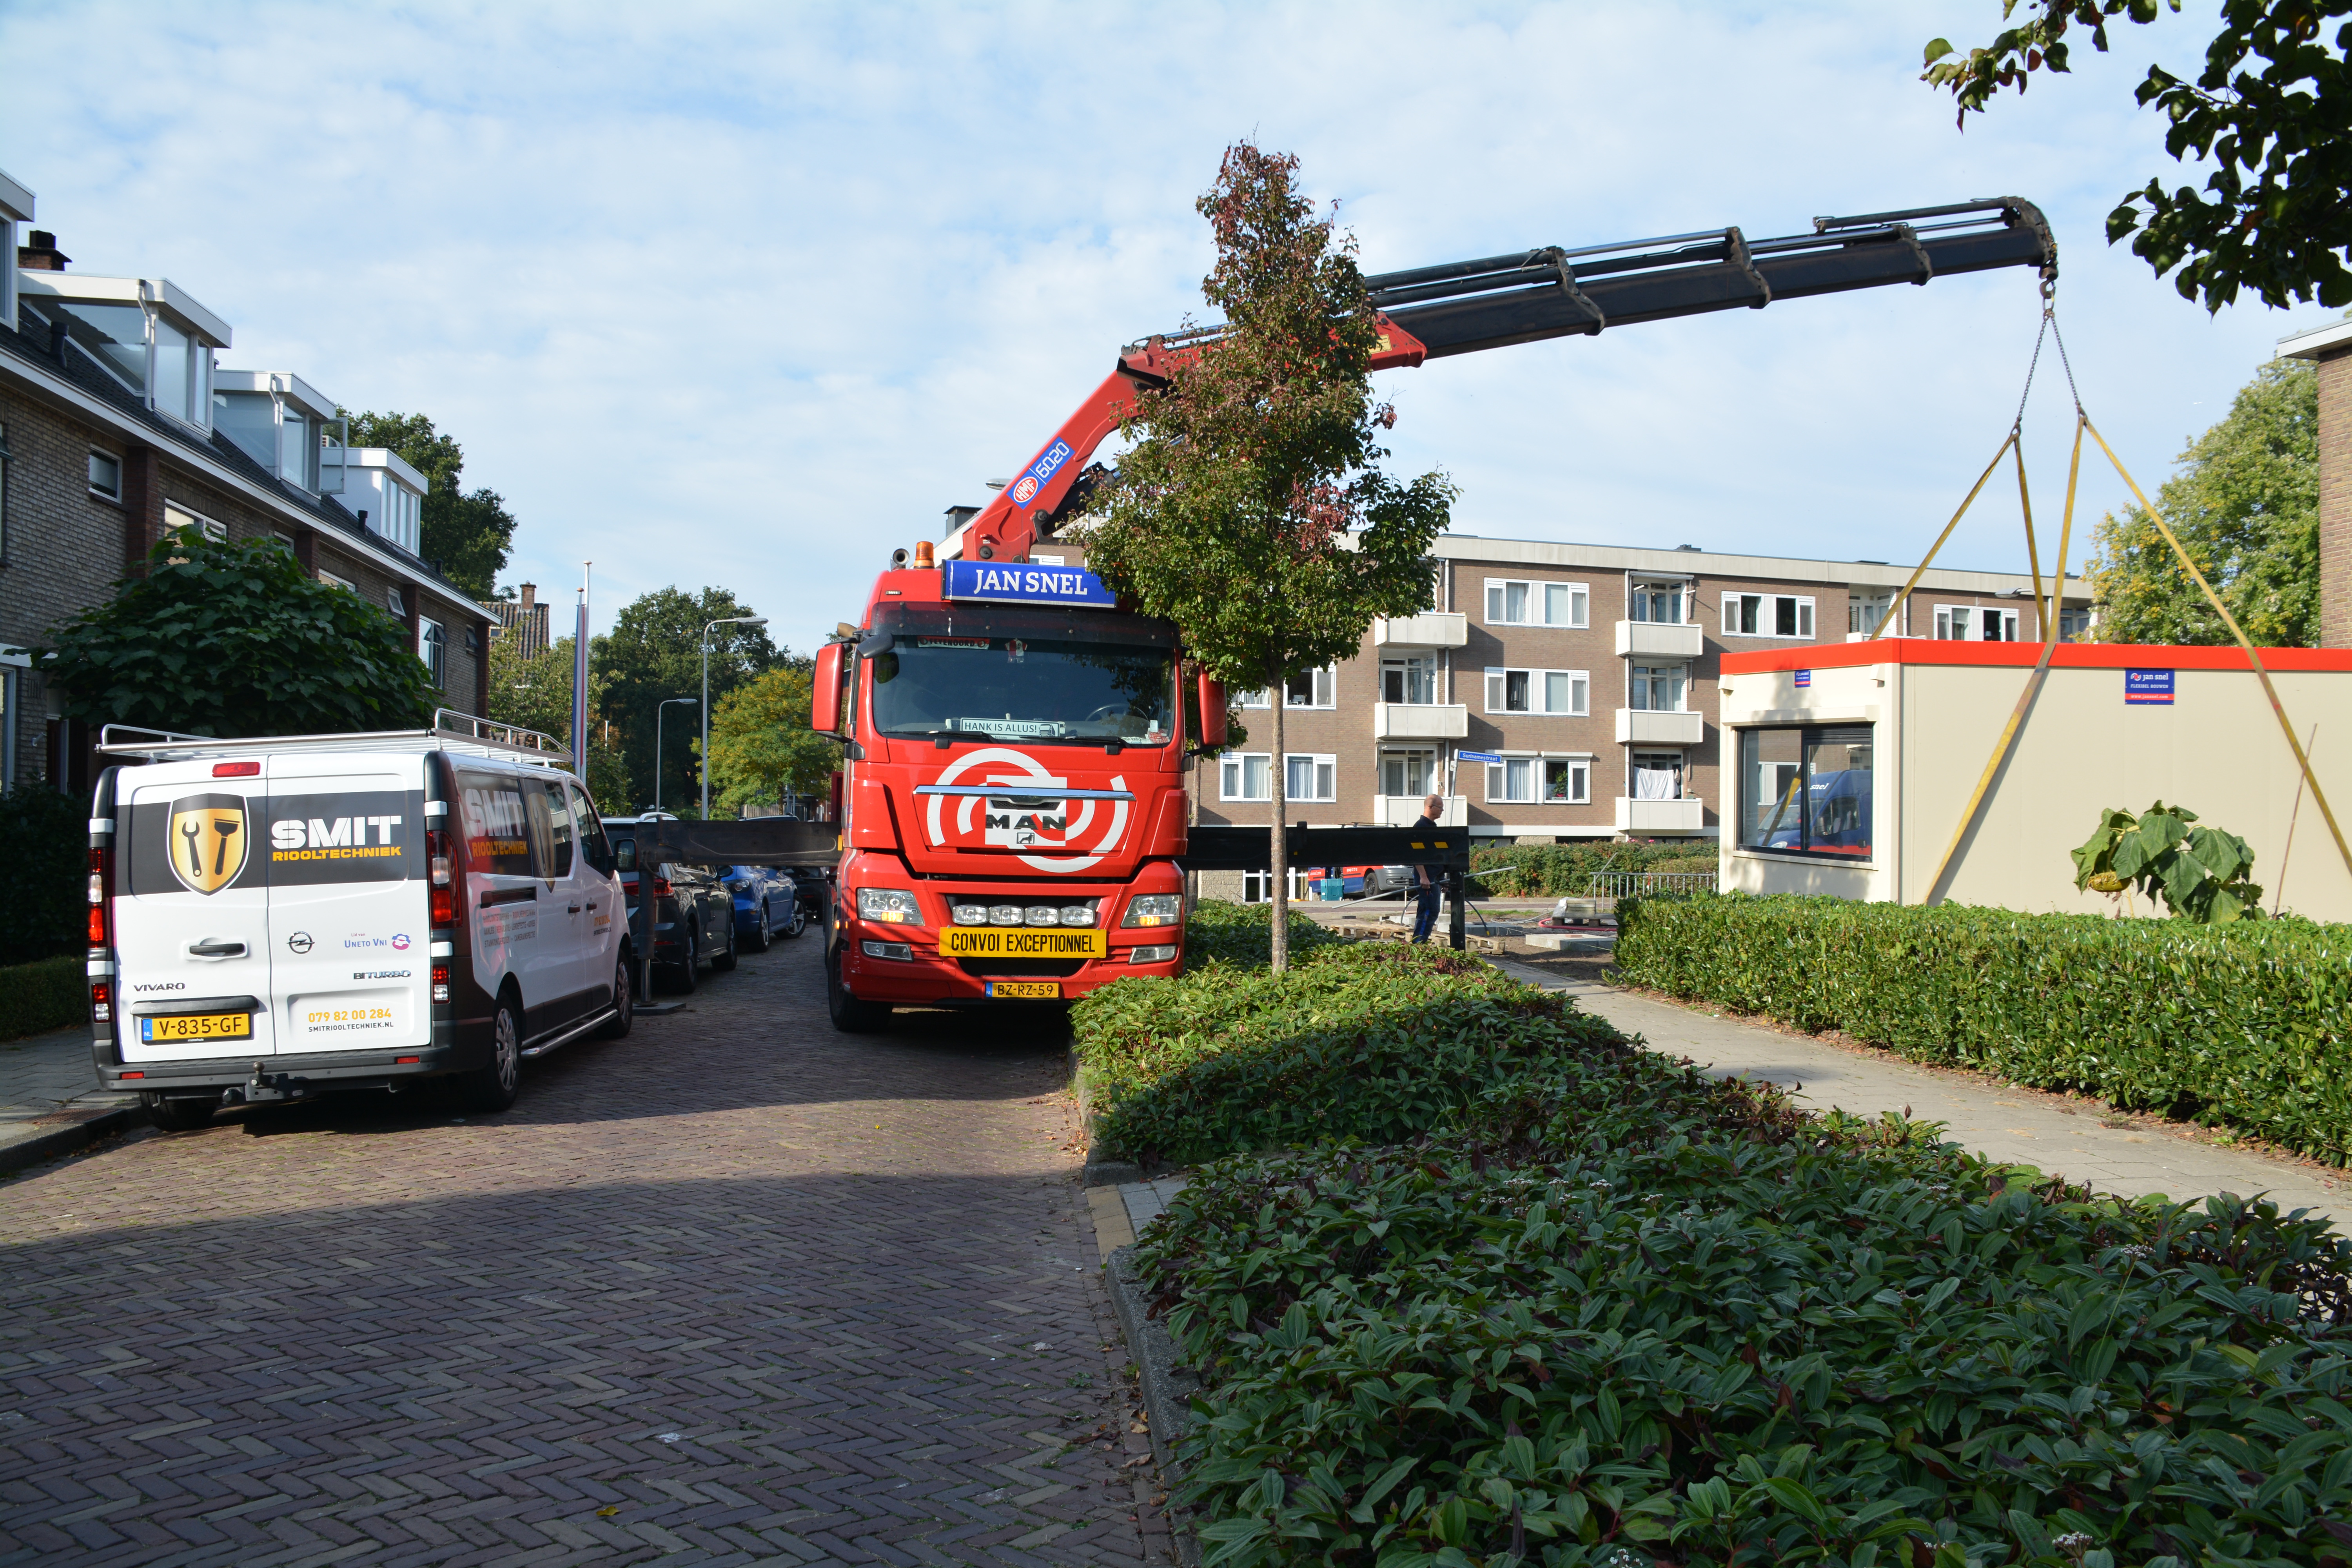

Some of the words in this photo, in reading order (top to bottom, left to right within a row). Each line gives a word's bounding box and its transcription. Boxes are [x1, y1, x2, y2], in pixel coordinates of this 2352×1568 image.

[1016, 479, 1035, 500] HMF
[1035, 442, 1069, 478] 6020
[974, 570, 1021, 594] JAN
[1025, 572, 1087, 595] SNEL
[965, 722, 992, 731] HANK
[995, 723, 1003, 731] IS
[1005, 724, 1037, 733] ALLUS!
[1463, 753, 1498, 761] Surinamestraat
[465, 789, 523, 837] SMIT
[985, 814, 1066, 831] MAN
[272, 815, 402, 849] SMIT
[273, 846, 402, 861] RIOOLTECHNIEK
[472, 841, 528, 857] RIOOLTECHNIEK
[951, 933, 1000, 951] CONVOI
[1006, 934, 1095, 953] EXCEPTIONNEL
[354, 970, 411, 980] BITURBO
[133, 982, 185, 992] VIVARO
[998, 985, 1053, 995] BZ-RZ-59
[309, 1012, 330, 1022] 079
[334, 1011, 348, 1021] 82
[352, 1010, 366, 1020] 00
[370, 1008, 391, 1019] 284
[159, 1017, 241, 1036] V-835-GF
[309, 1022, 394, 1032] SMITRIOOLTECHNIEK.NL
